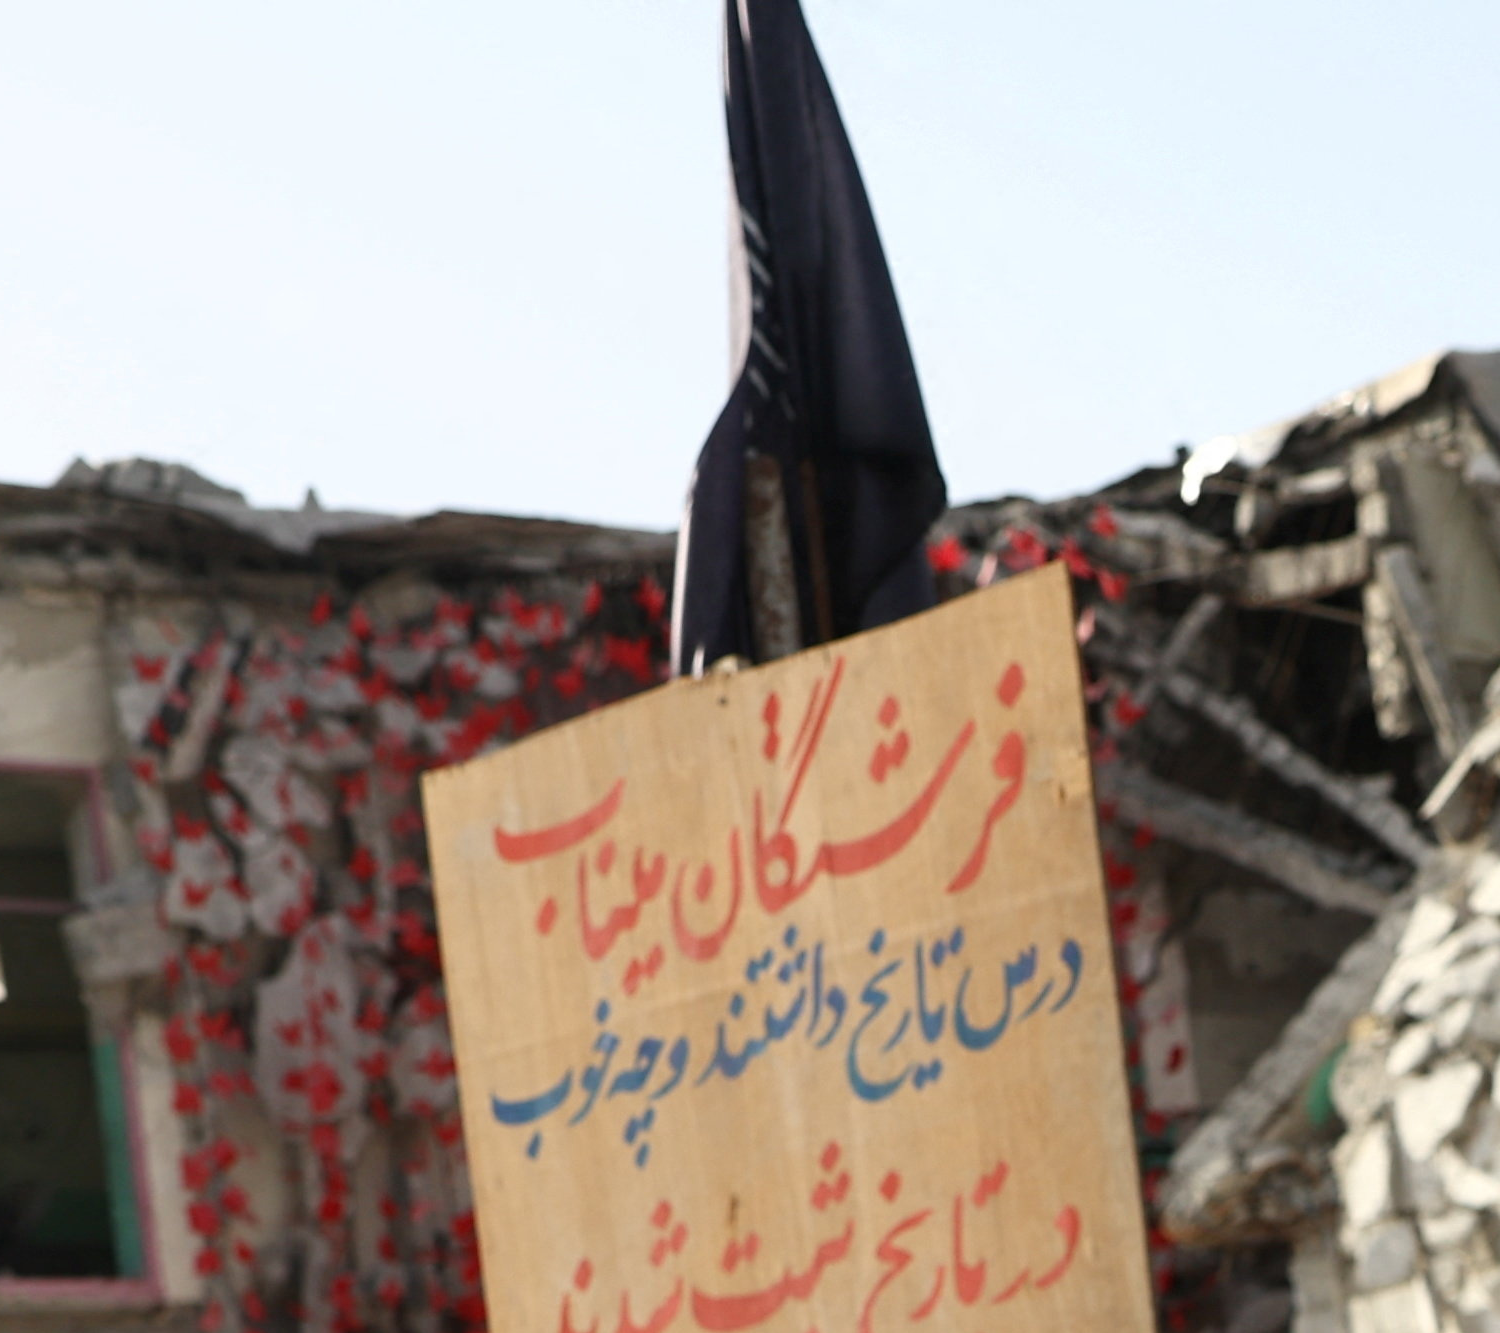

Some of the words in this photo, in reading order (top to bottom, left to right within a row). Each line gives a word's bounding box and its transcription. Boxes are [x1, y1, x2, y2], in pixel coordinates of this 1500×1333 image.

[493, 780, 667, 996] میناب
[671, 657, 1027, 962] فرشتگان
[696, 926, 847, 1079] داشتند
[845, 929, 966, 1102] تاریخ
[955, 938, 1083, 1050] درس
[491, 1000, 620, 1160] خوب
[992, 1205, 1082, 1306] در
